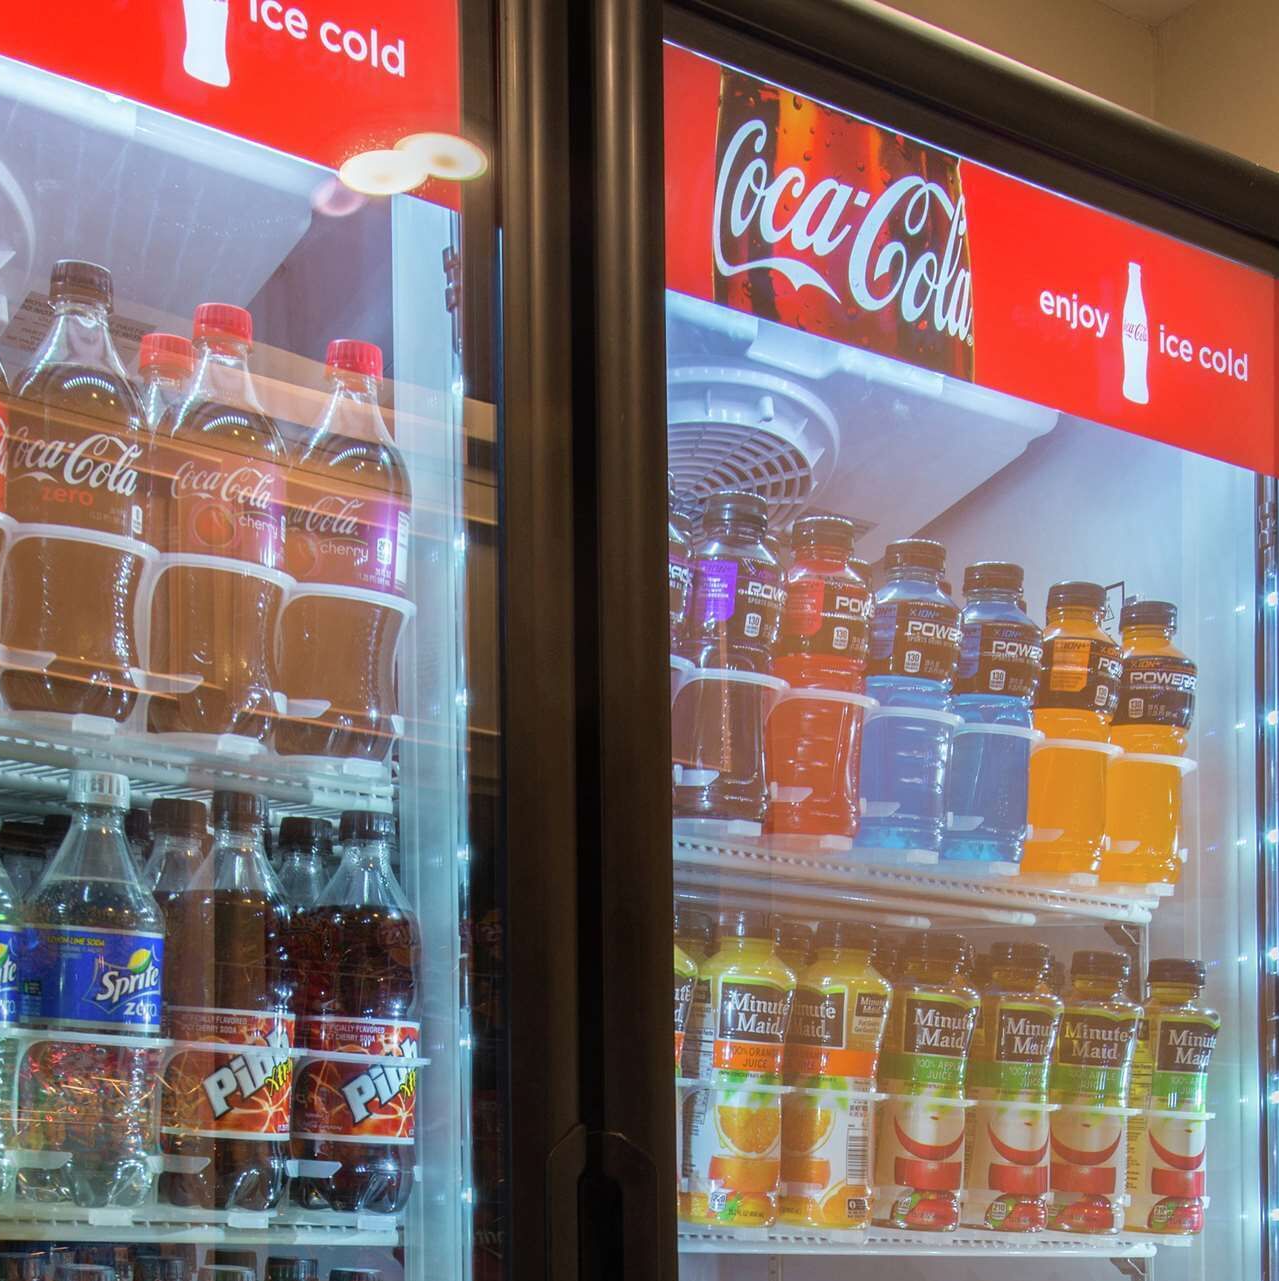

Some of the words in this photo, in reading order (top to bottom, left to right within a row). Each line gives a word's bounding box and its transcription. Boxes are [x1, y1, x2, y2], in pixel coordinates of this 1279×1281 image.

[249, 0, 308, 40] ice
[320, 21, 406, 77] cold
[714, 119, 974, 342] Coca-Cola
[1039, 289, 1109, 338] enjoy
[1159, 324, 1193, 362] ice
[1199, 347, 1248, 381] cold
[41, 486, 94, 507] zero
[239, 515, 279, 539] cherry
[319, 541, 369, 562] cherry
[1129, 672, 1198, 690] POWERA
[96, 964, 159, 1004] Sprite
[124, 1001, 158, 1017] zero
[728, 988, 789, 1017] Minute
[735, 1011, 784, 1036] Maid
[1064, 1021, 1132, 1042] Minute
[920, 1029, 964, 1050] Maid
[1168, 1029, 1217, 1049] Minute
[1071, 1042, 1119, 1060] Maid
[1174, 1047, 1211, 1066] Maid
[742, 1057, 768, 1068] JUICE
